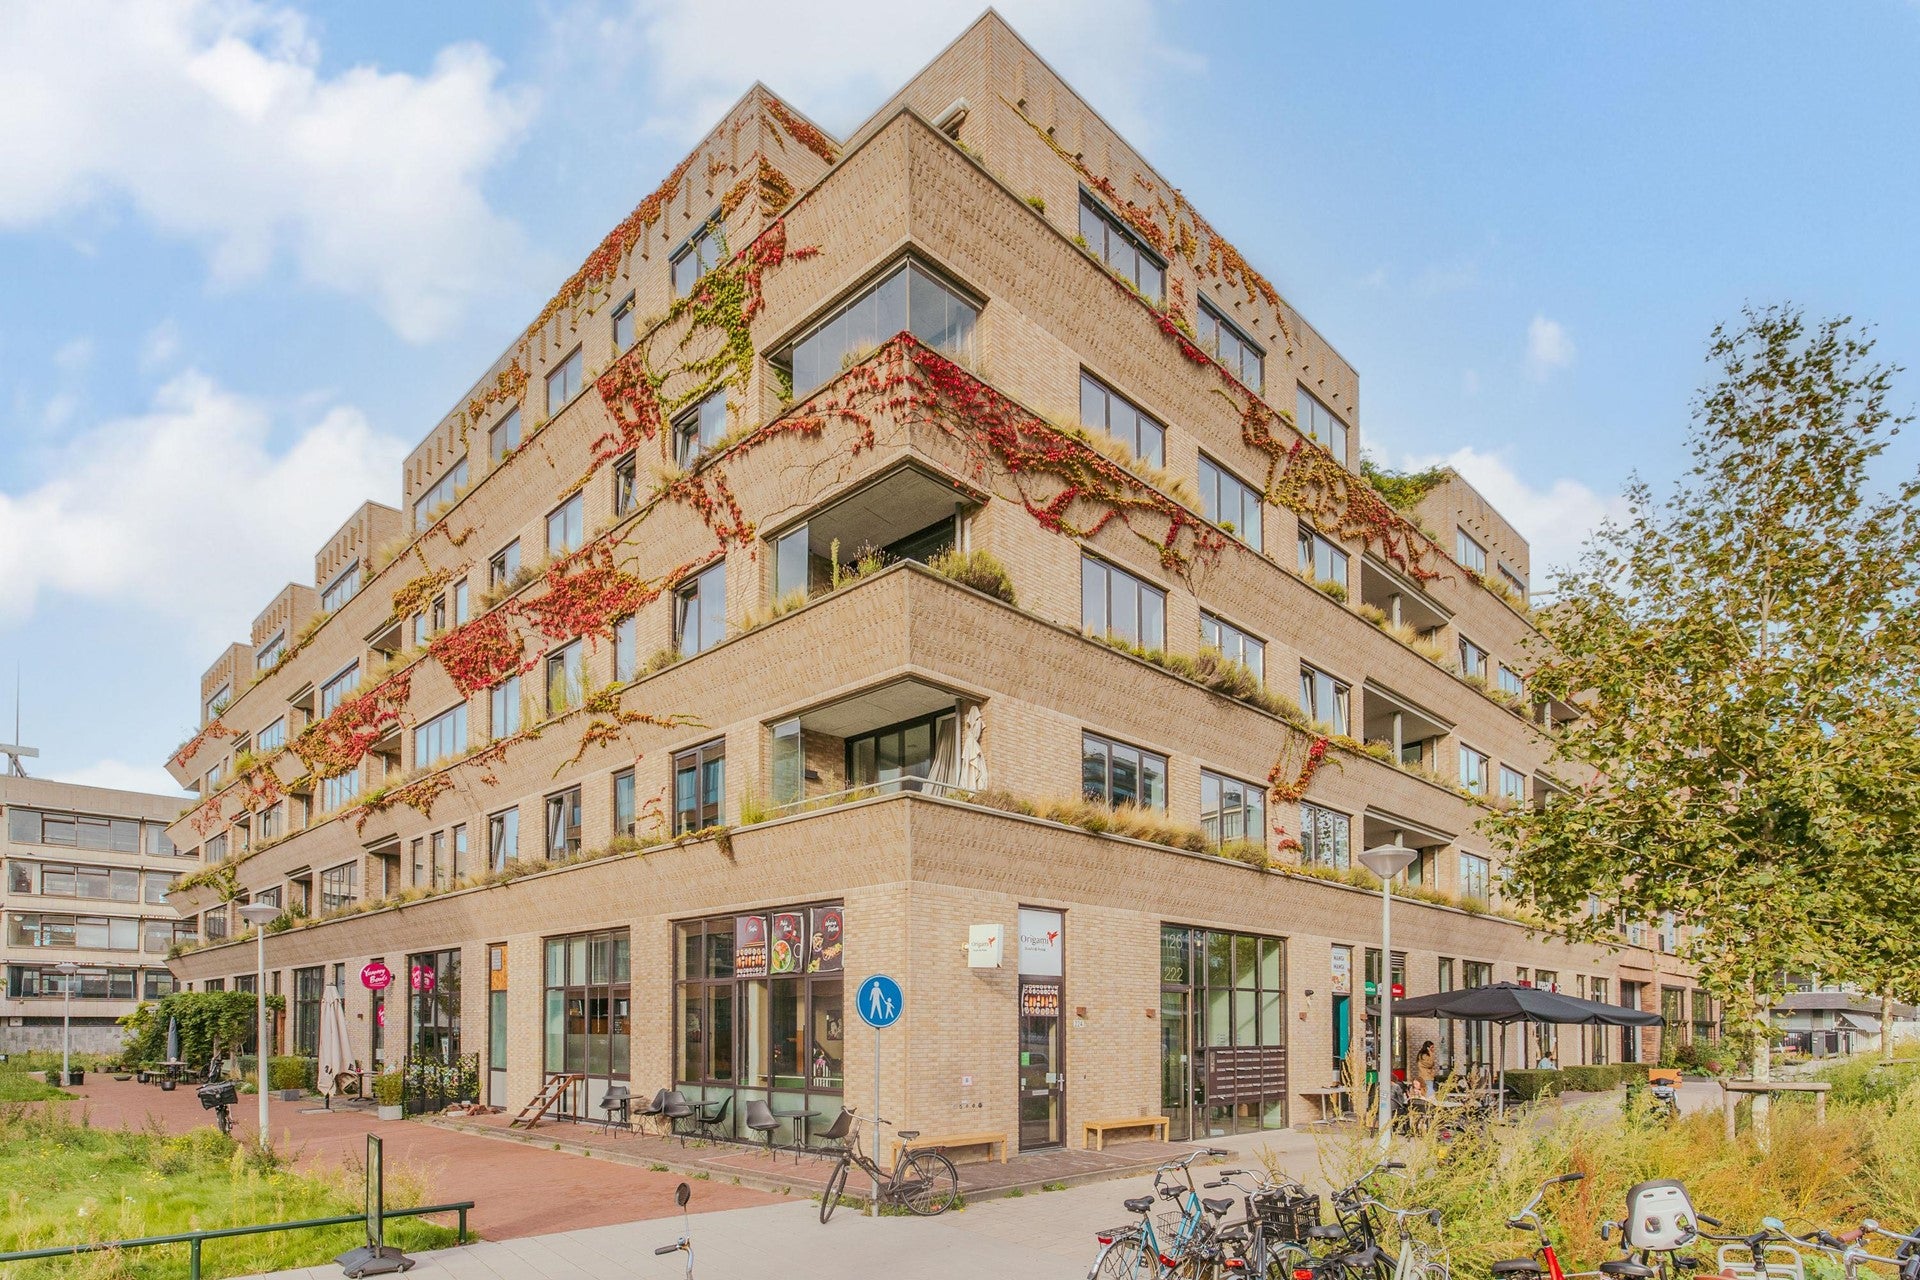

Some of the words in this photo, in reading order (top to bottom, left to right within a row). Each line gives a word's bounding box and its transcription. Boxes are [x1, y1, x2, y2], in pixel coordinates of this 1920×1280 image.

[971, 941, 989, 949] Origami
[1021, 934, 1048, 945] Origami
[1165, 934, 1183, 949] 126
[1165, 967, 1183, 982] 222
